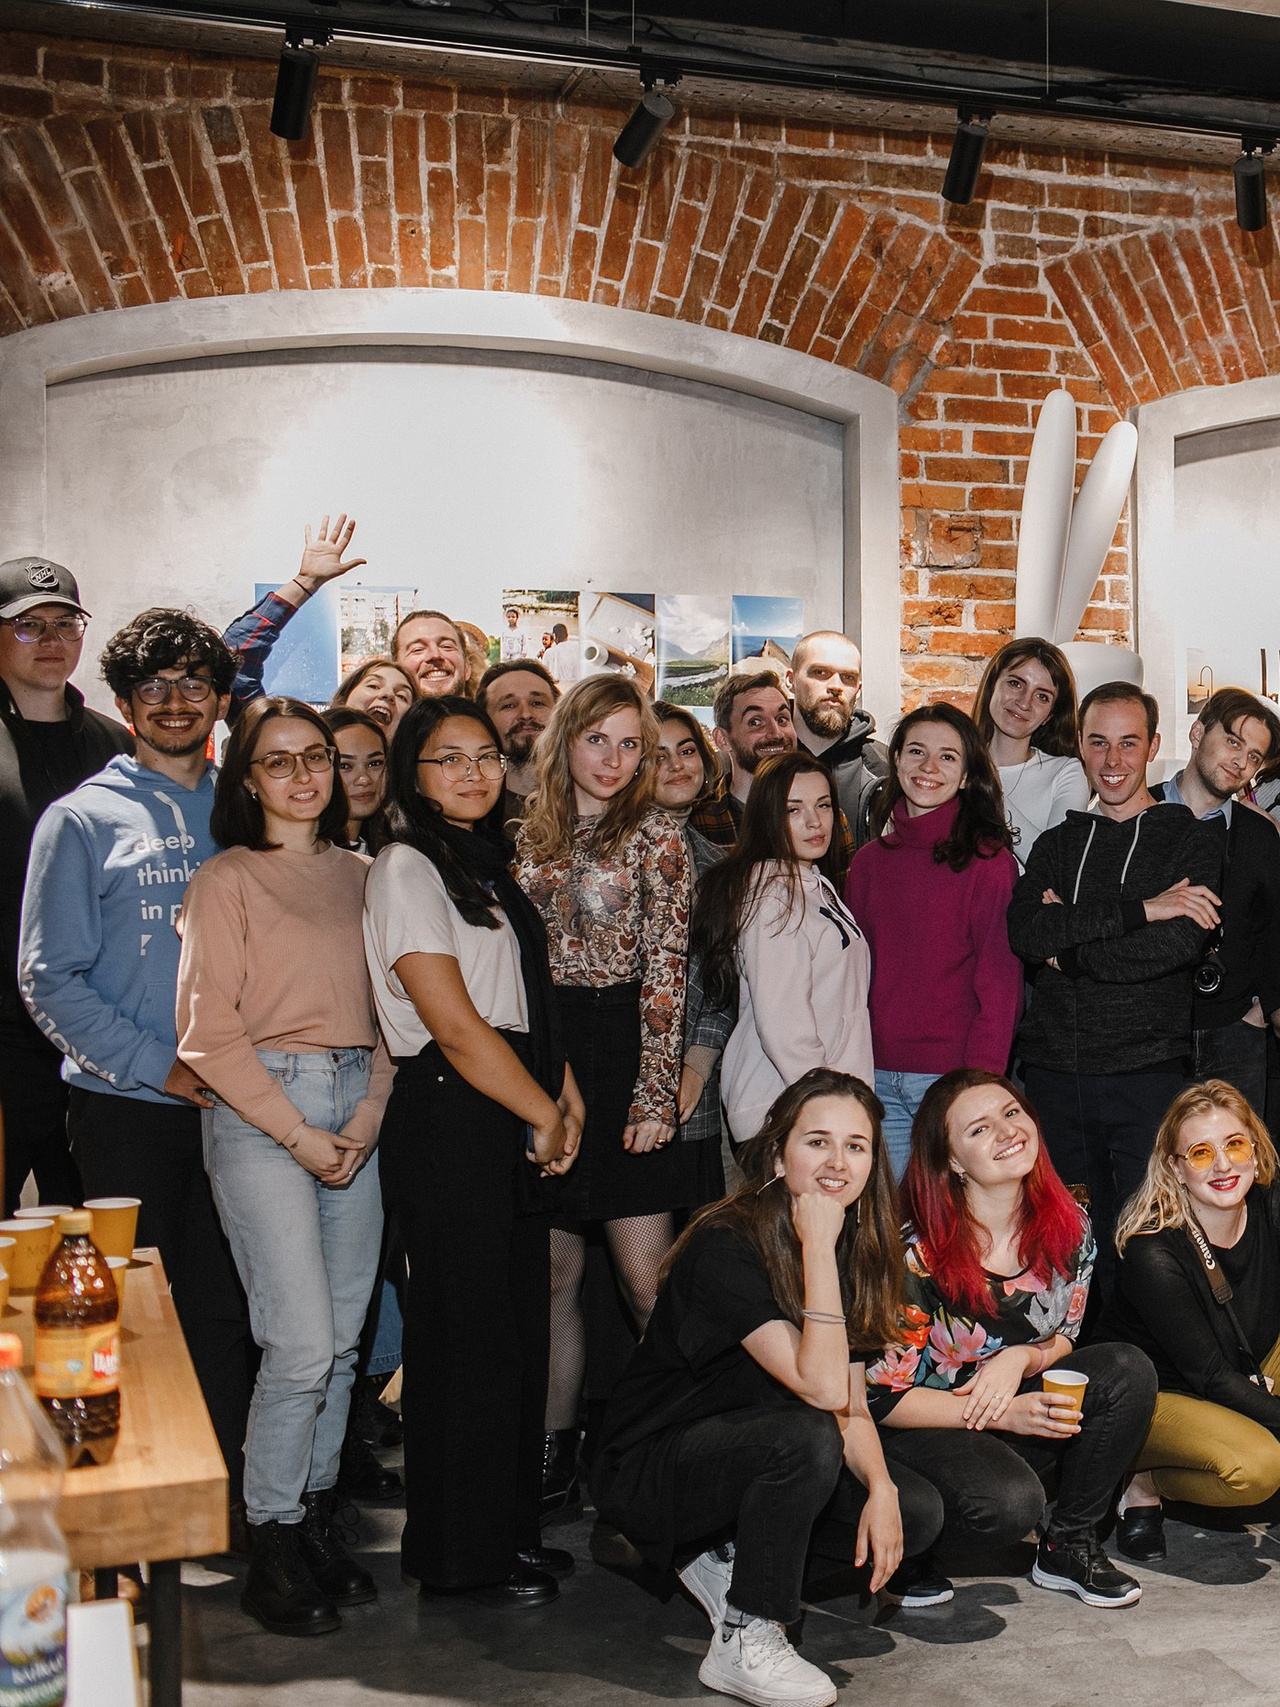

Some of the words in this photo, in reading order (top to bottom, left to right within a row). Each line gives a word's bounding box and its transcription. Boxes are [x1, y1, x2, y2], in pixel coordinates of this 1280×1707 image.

[34, 567, 51, 582] NHL
[140, 899, 163, 920] in
[1192, 1230, 1216, 1270] Canon
